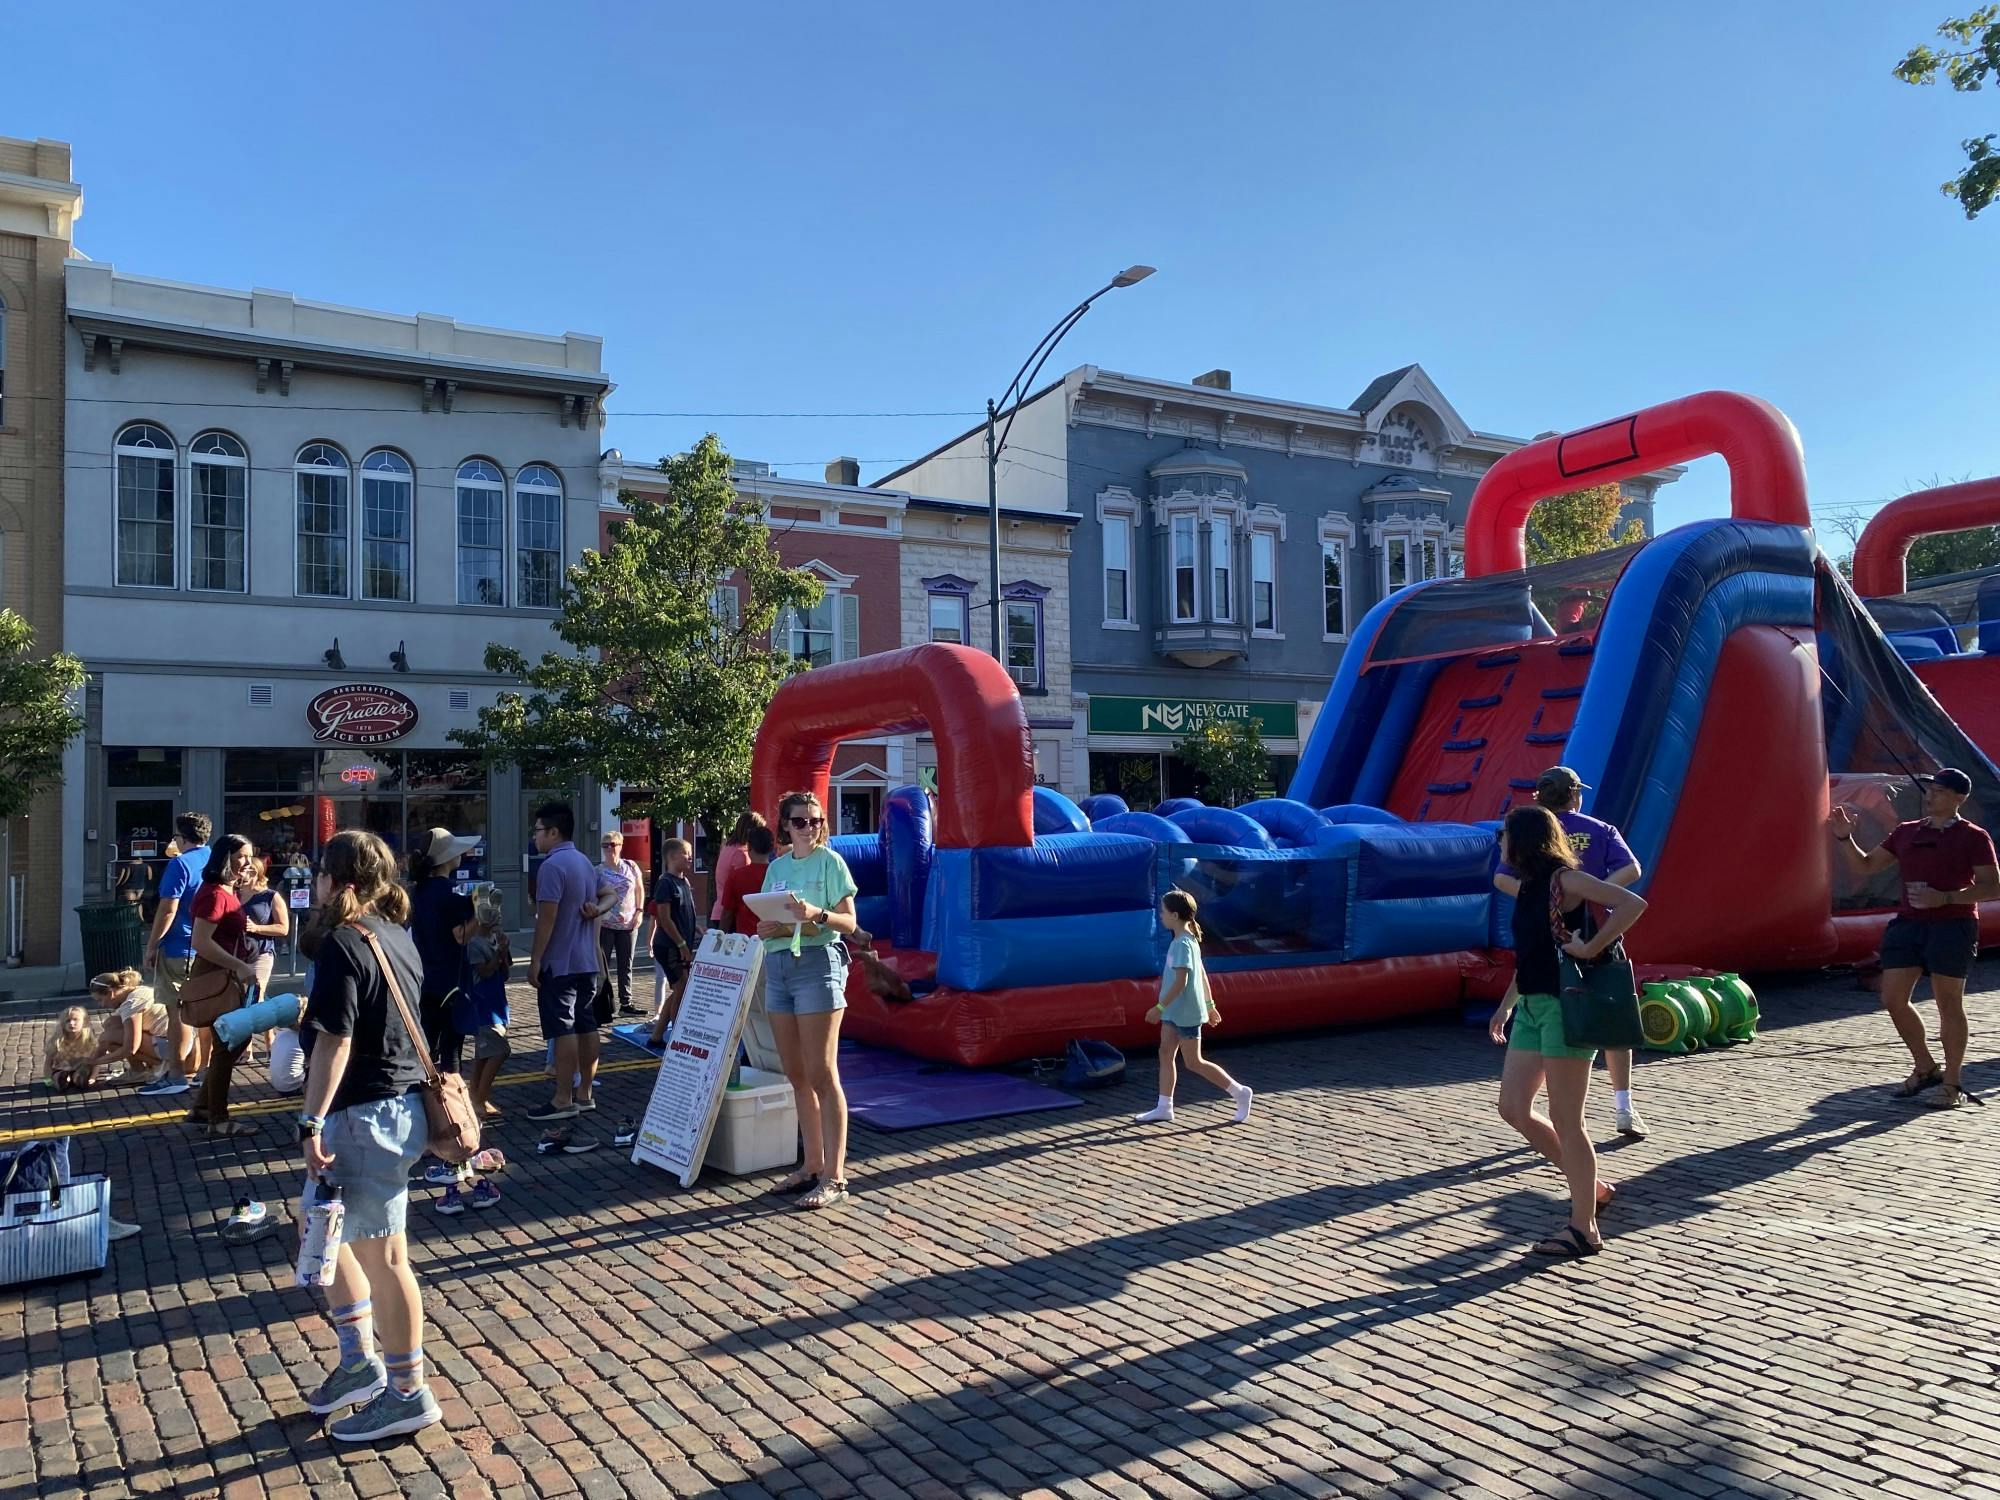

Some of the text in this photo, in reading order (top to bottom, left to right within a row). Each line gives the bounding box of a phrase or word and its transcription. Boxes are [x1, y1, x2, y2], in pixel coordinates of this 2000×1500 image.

[314, 697, 414, 739] Graeter's
[333, 730, 401, 743] ICE CREAM
[341, 768, 377, 783] OPEN
